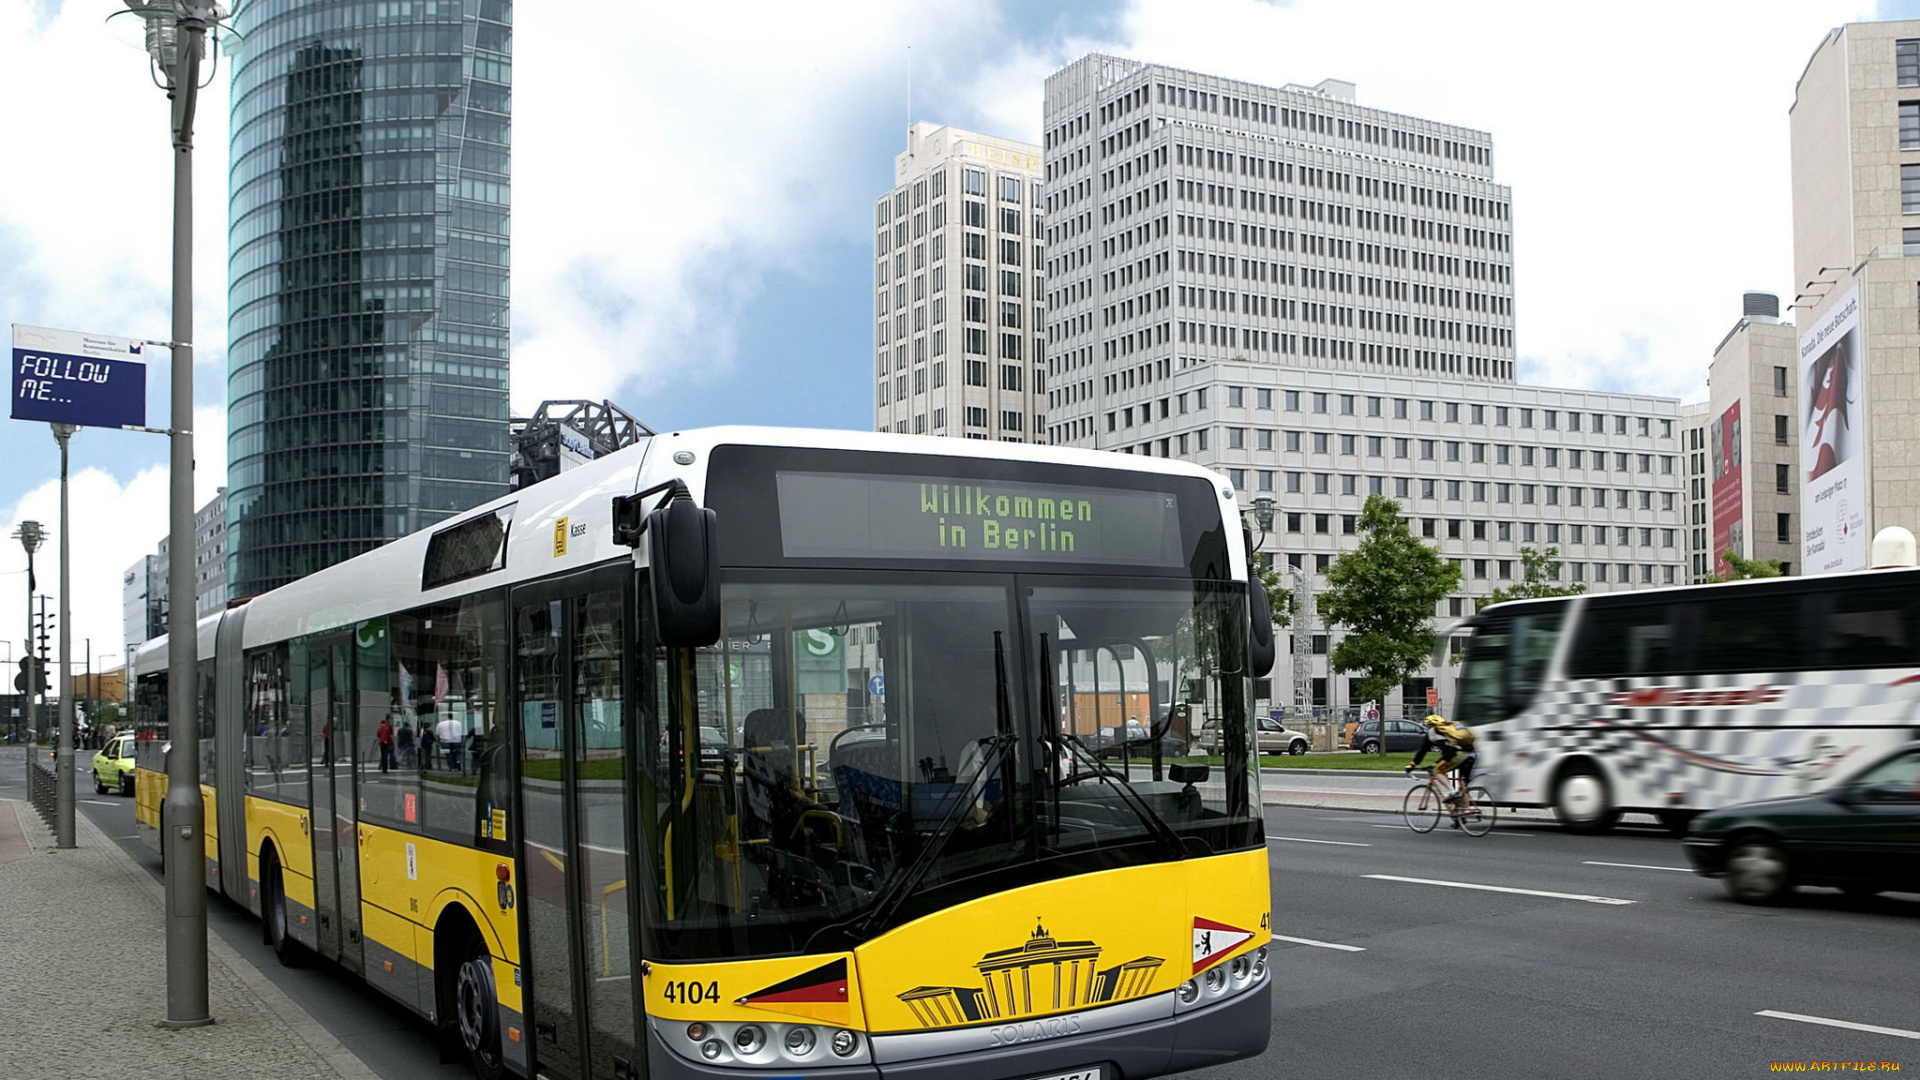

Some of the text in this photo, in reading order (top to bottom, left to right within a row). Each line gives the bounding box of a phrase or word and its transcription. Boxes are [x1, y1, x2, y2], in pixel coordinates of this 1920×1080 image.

[20, 355, 110, 383] FOLLOW
[20, 379, 72, 403] ME...
[921, 484, 1091, 521] Willkommen
[570, 523, 586, 538] Kasse
[939, 517, 1074, 552] in Berlin
[1260, 911, 1270, 931] 41
[664, 981, 720, 1004] 4104
[989, 1015, 1081, 1047] SOLARIS
